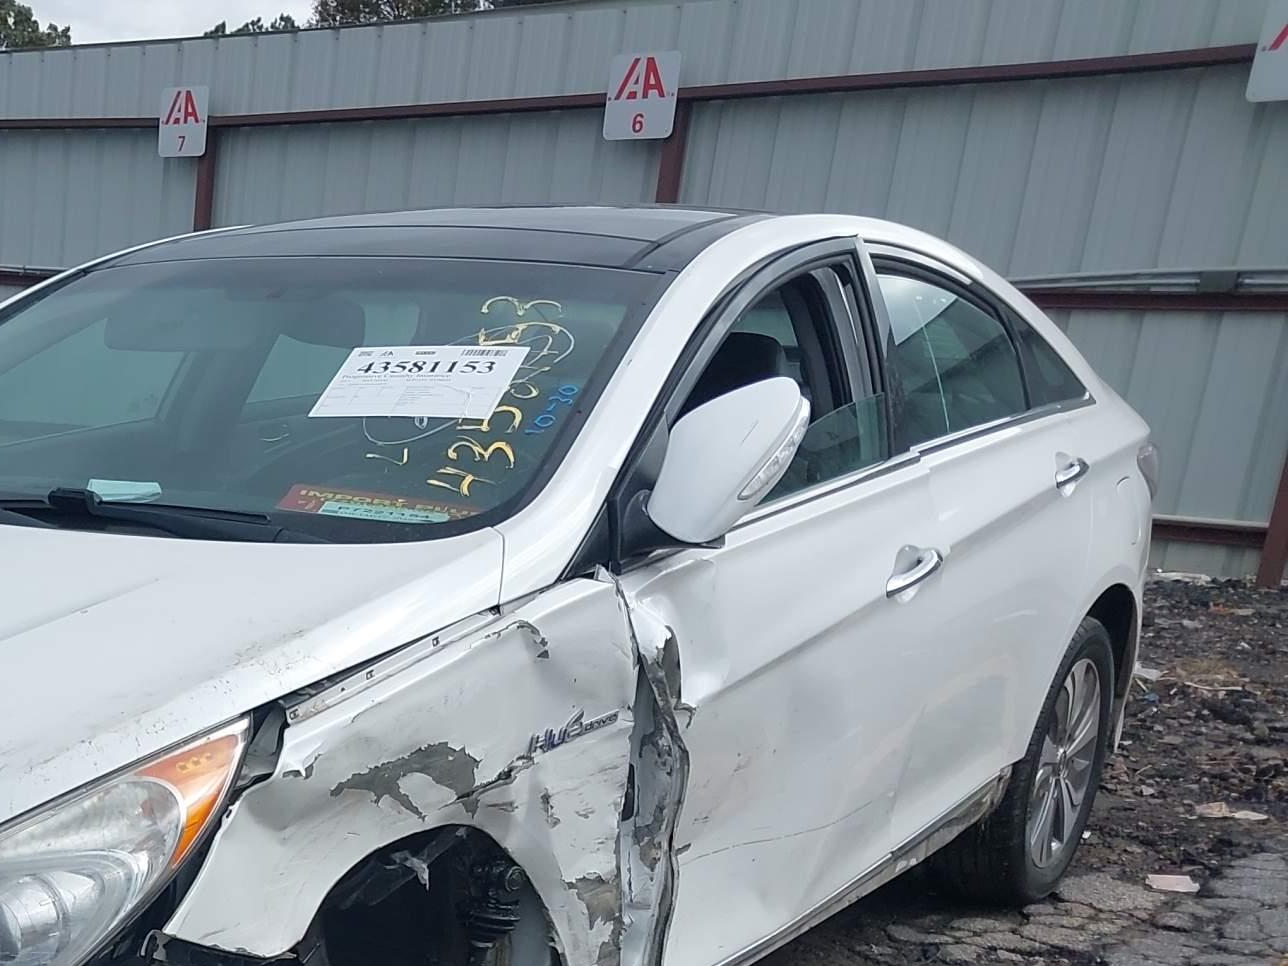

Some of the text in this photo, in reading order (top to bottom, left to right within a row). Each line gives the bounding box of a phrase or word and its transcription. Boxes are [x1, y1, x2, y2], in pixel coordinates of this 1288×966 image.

[632, 113, 644, 133] 6
[177, 135, 186, 152] 7
[357, 360, 497, 374] 43581153
